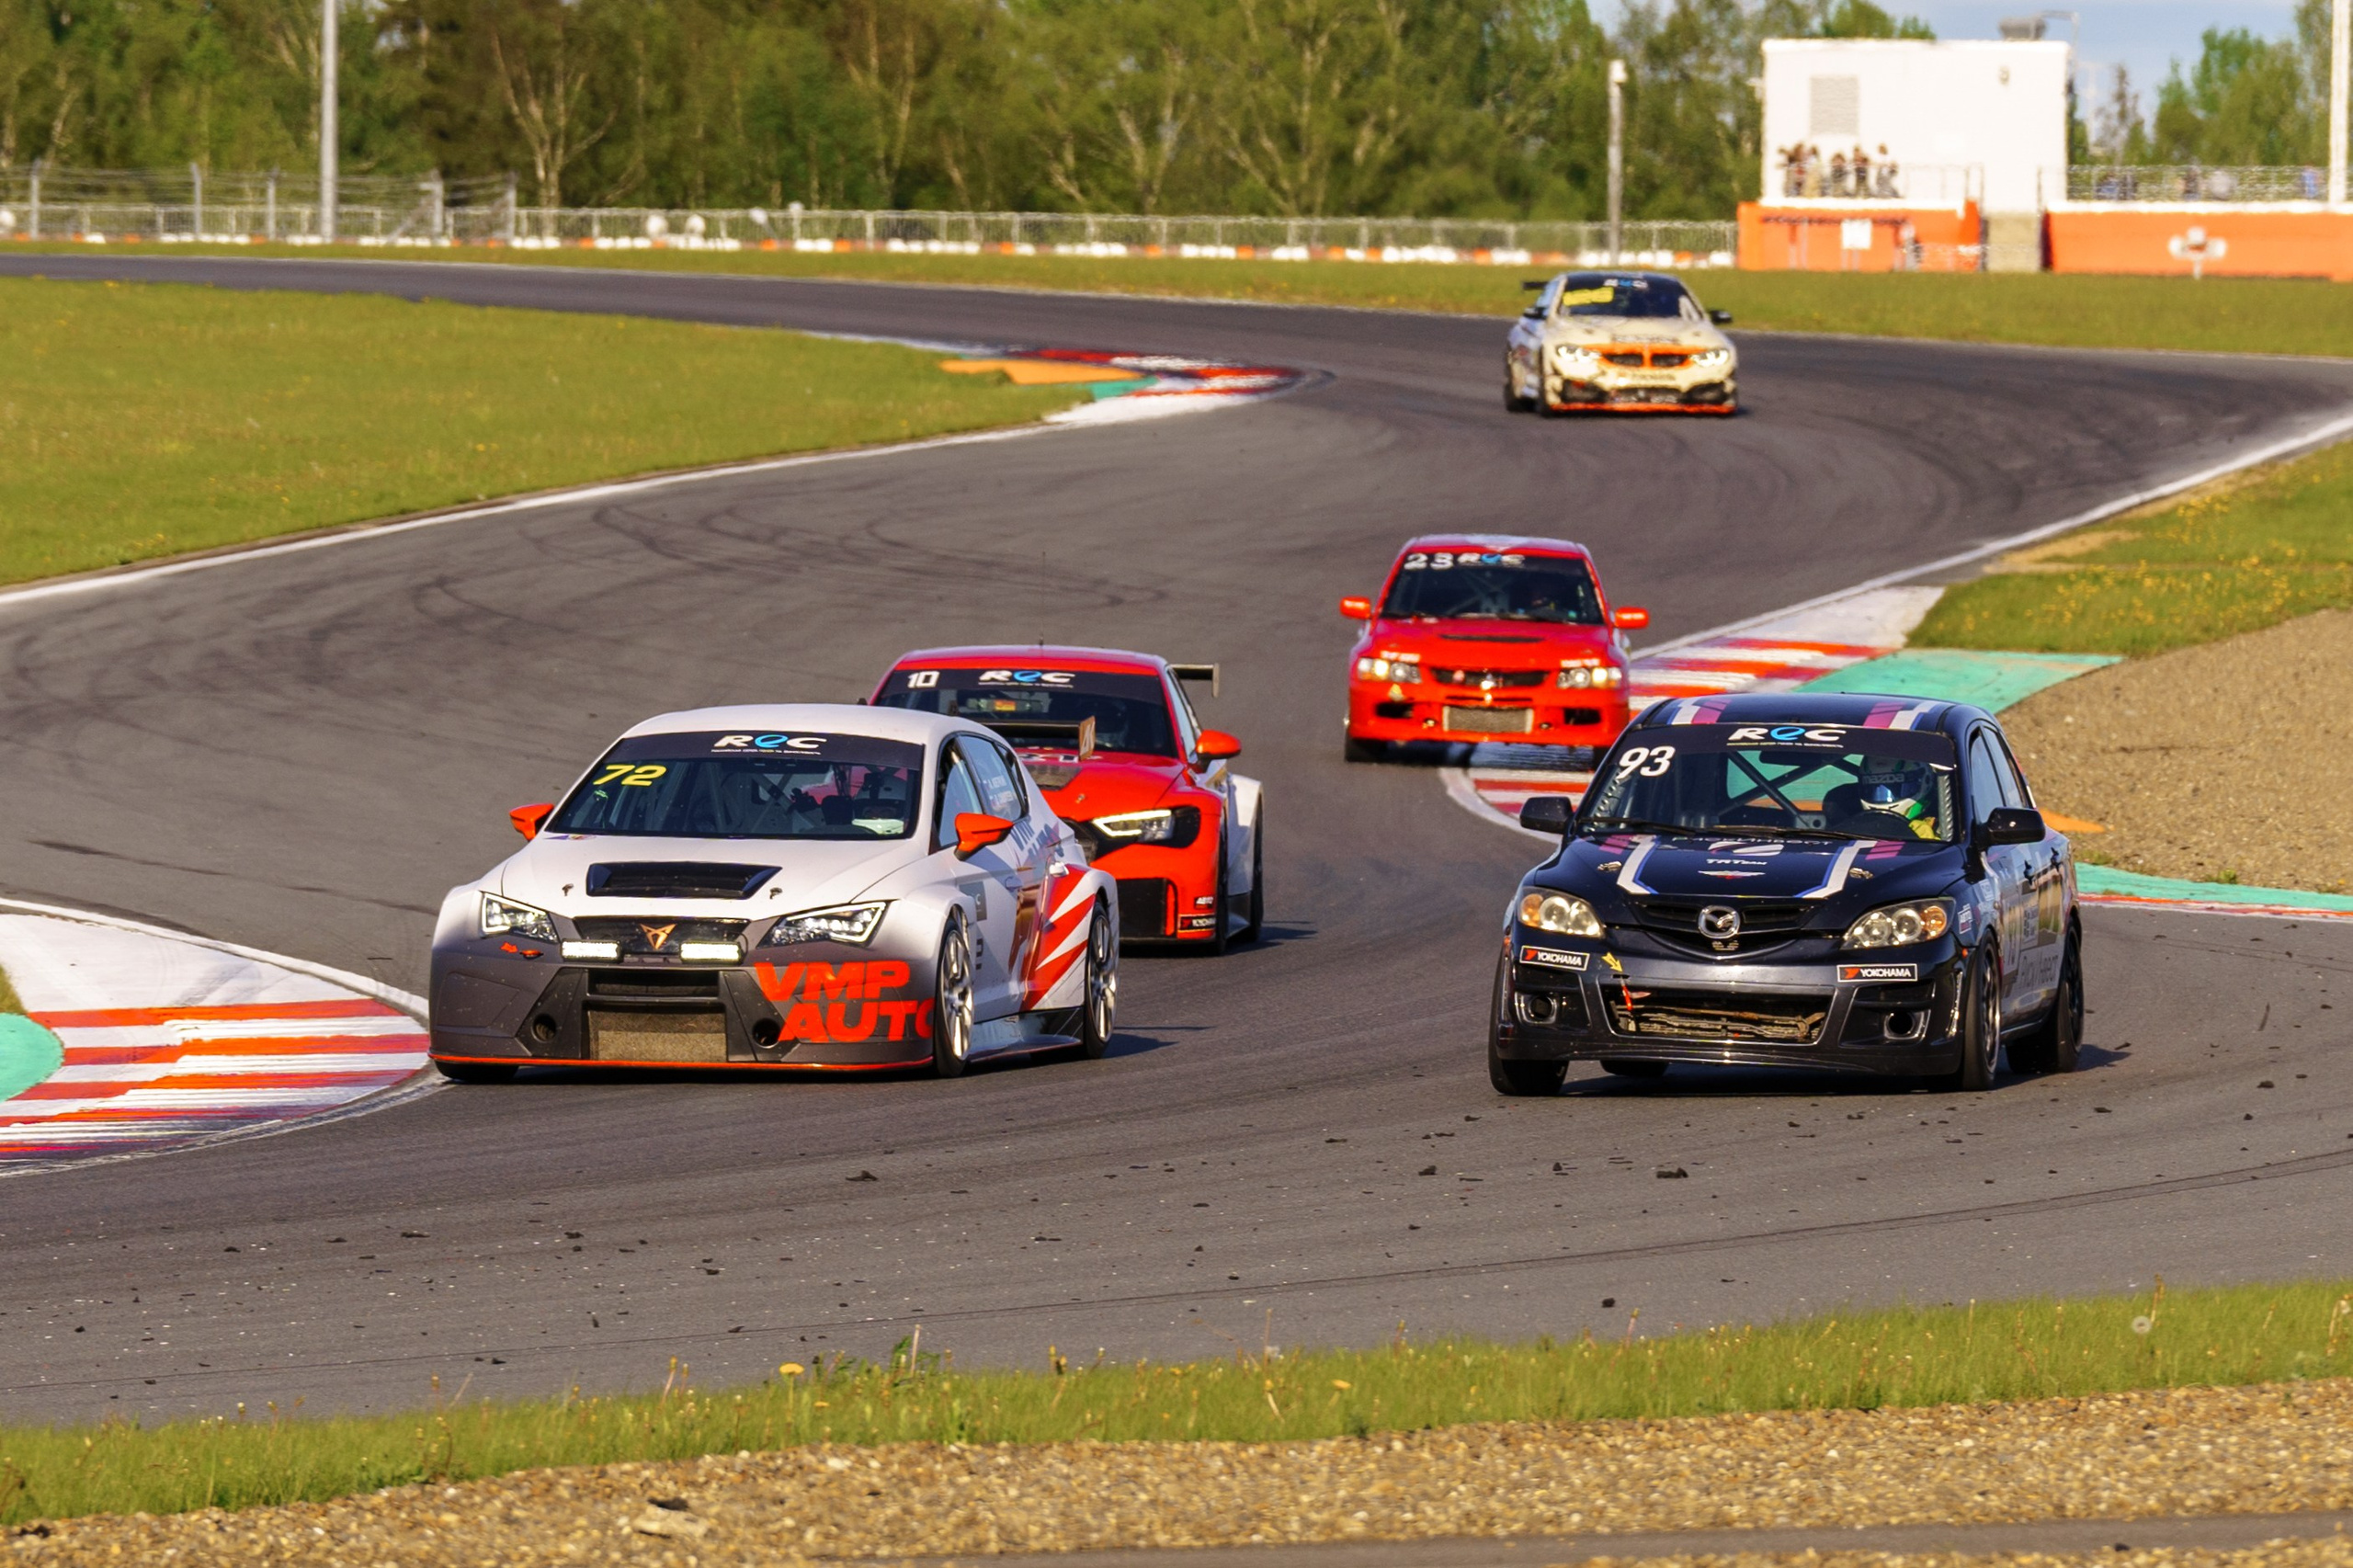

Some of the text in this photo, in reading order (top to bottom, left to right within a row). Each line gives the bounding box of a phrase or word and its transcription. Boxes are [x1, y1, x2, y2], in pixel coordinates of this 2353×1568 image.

[1404, 552, 1453, 570] 23
[907, 671, 939, 688] 10
[1615, 745, 1676, 779] 93
[593, 764, 667, 786] 72
[1538, 951, 1582, 966] YOKOHAMA
[753, 960, 911, 1001] VMP
[1859, 968, 1912, 978] YOKOHAMA
